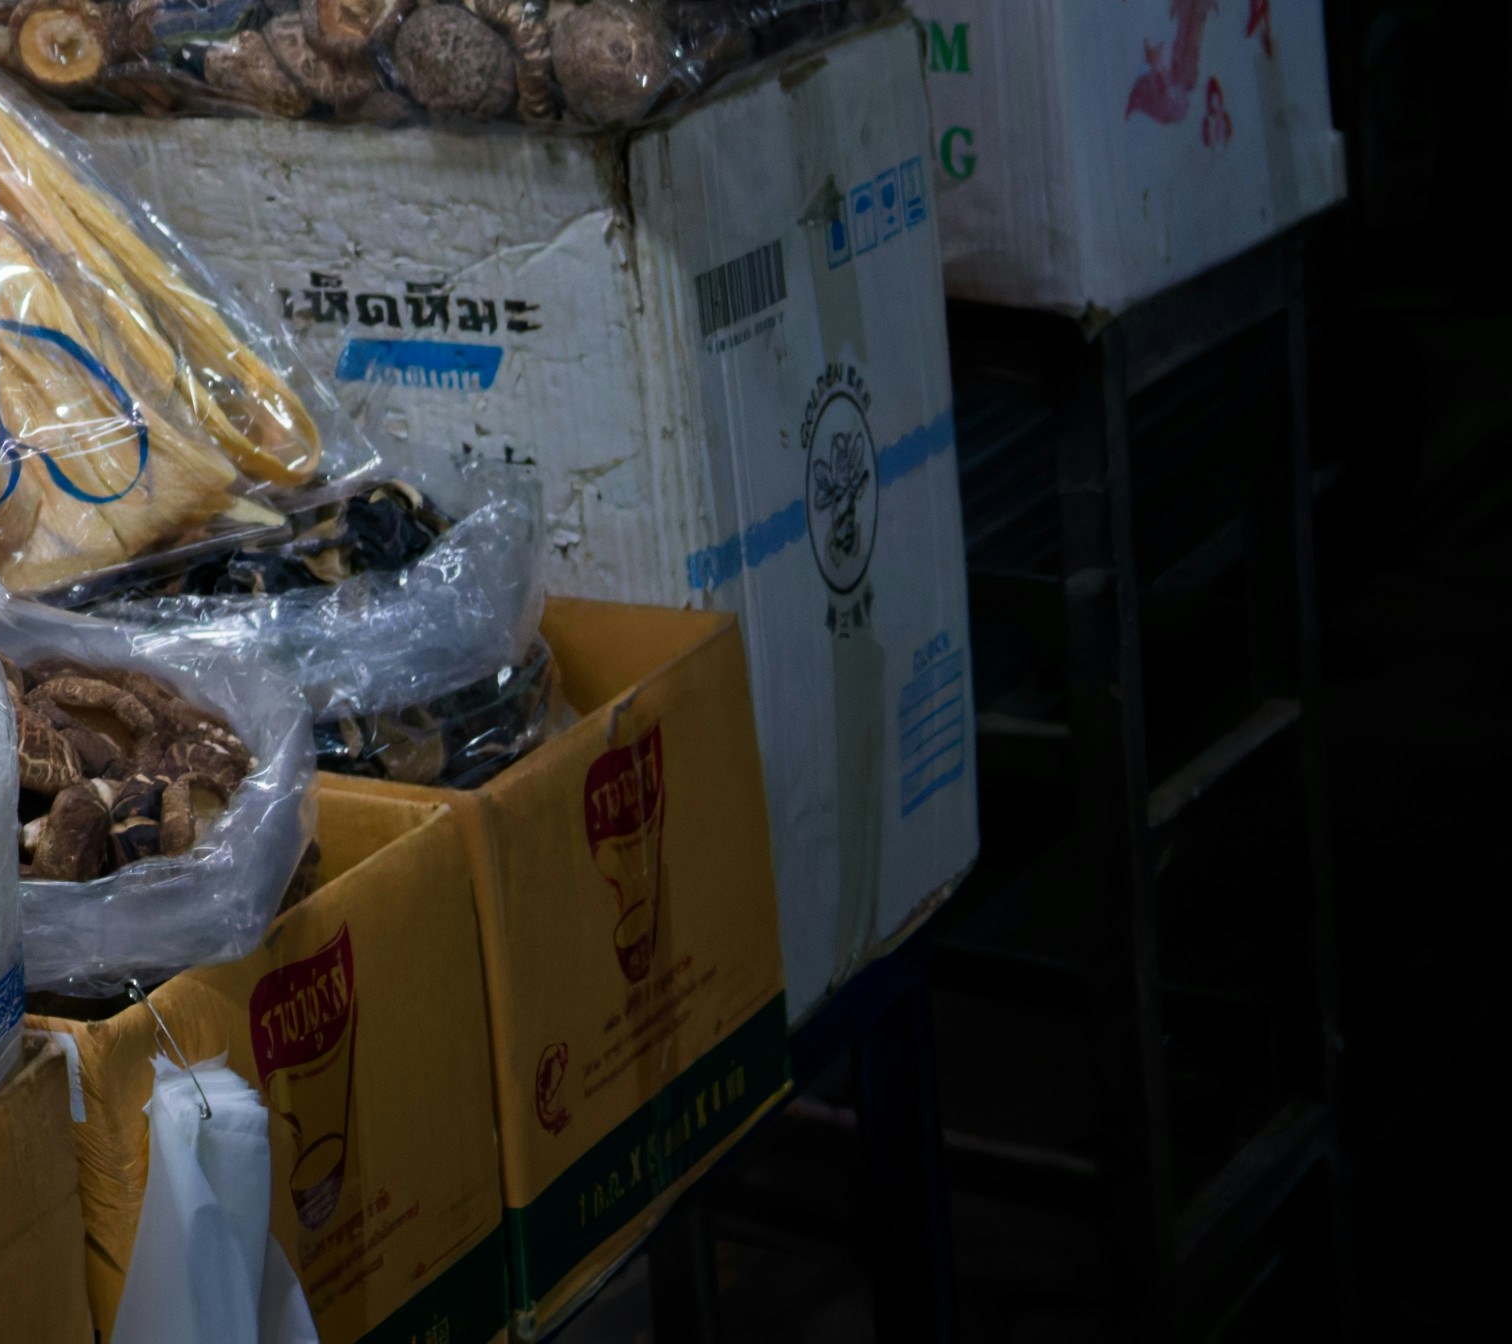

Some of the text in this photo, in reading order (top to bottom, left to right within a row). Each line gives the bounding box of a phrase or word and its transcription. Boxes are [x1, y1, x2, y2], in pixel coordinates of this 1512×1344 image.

[930, 22, 973, 75] M
[940, 126, 978, 182] G
[260, 957, 349, 1059] ราชาชูรส
